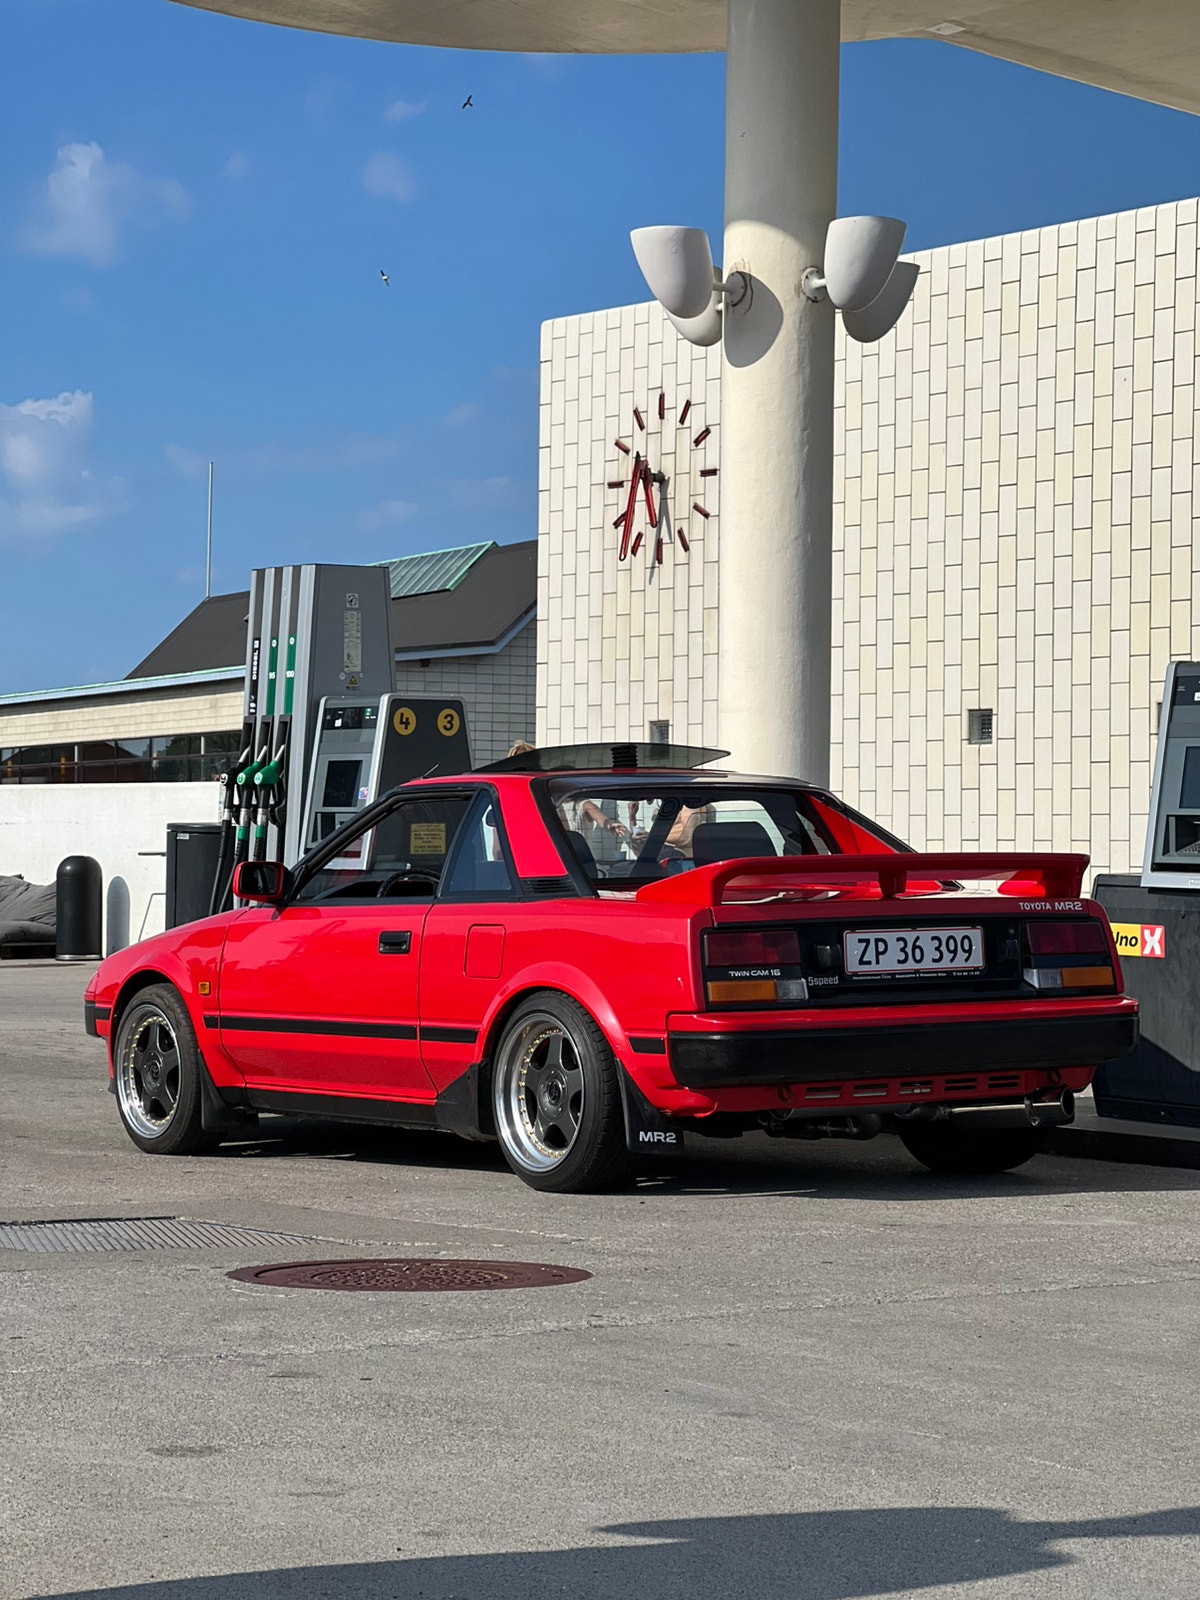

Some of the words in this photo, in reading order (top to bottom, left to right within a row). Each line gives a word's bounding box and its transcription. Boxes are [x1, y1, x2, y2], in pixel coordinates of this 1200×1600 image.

[286, 670, 295, 678] 100
[400, 713, 410, 730] 4
[443, 714, 454, 731] 3
[1018, 902, 1052, 911] TOYOTA
[1055, 901, 1083, 911] MR2
[1143, 927, 1163, 955] X
[857, 937, 889, 966] ZP
[895, 935, 925, 965] 36
[930, 934, 973, 964] 399
[808, 976, 839, 986] 5speed
[639, 1131, 677, 1143] MR2
